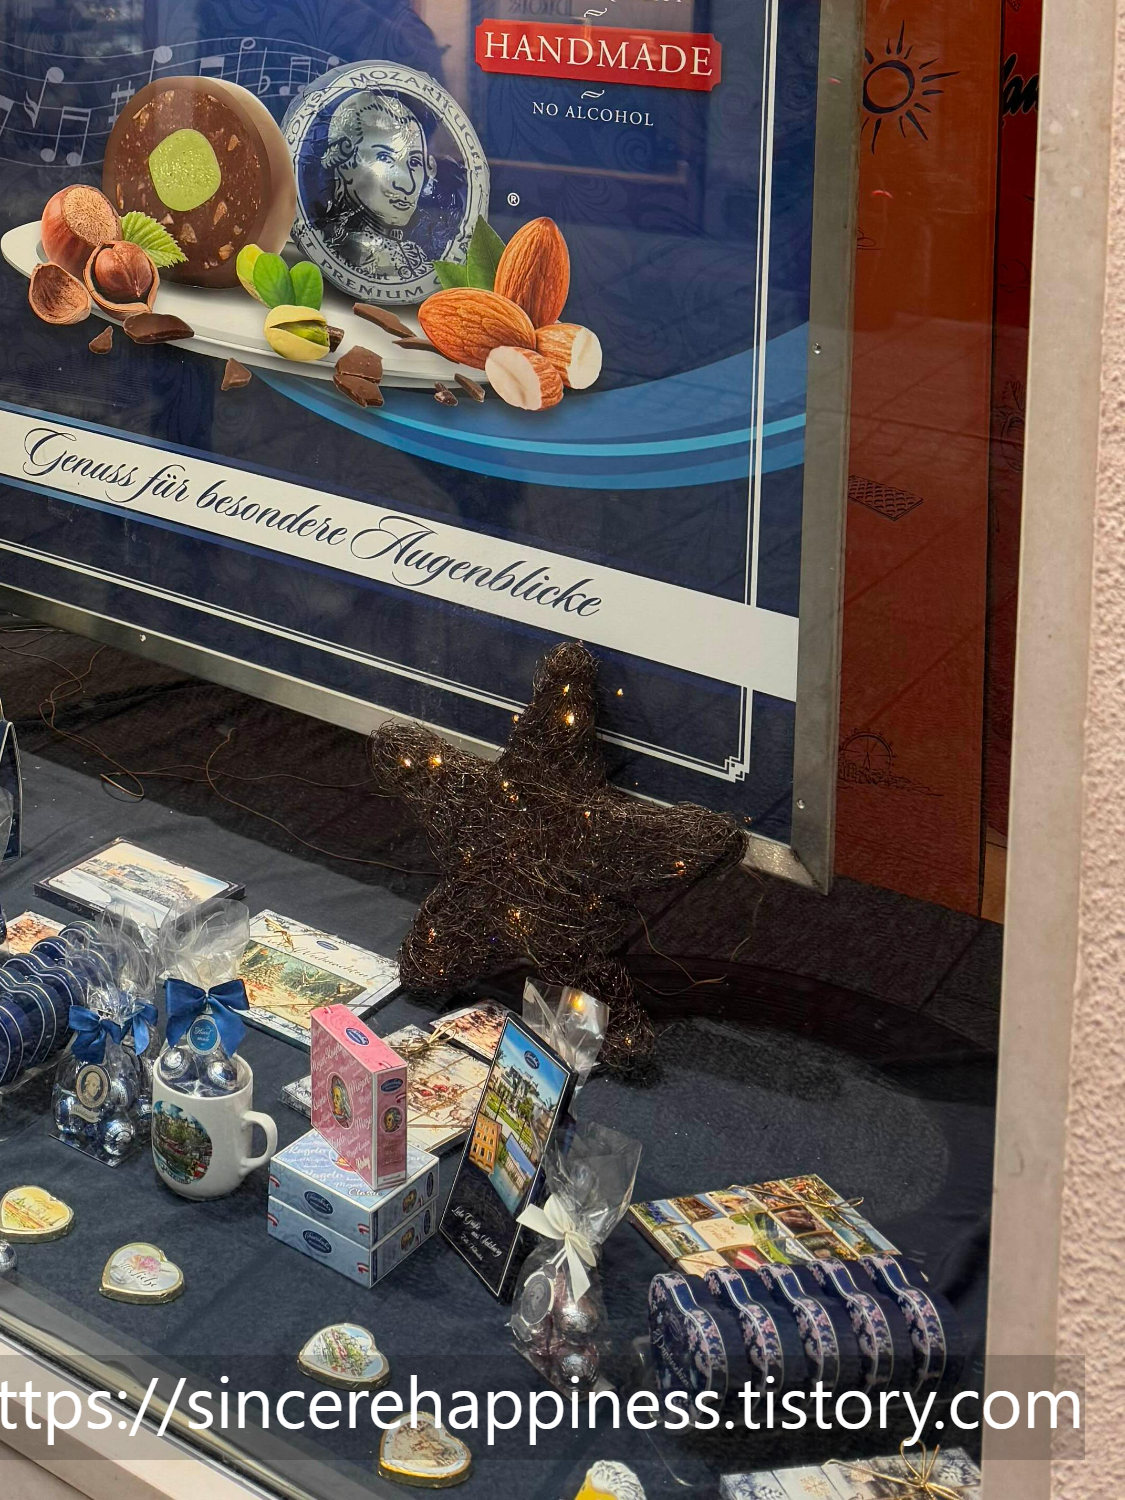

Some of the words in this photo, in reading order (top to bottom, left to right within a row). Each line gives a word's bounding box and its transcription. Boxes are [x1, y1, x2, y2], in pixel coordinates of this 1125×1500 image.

[484, 31, 714, 77] HANDMADE
[532, 101, 559, 117] NO
[565, 104, 654, 127] ALCOHOL
[23, 427, 139, 488] Genuss
[195, 477, 350, 548] besondere
[349, 514, 604, 618] Augenblicke
